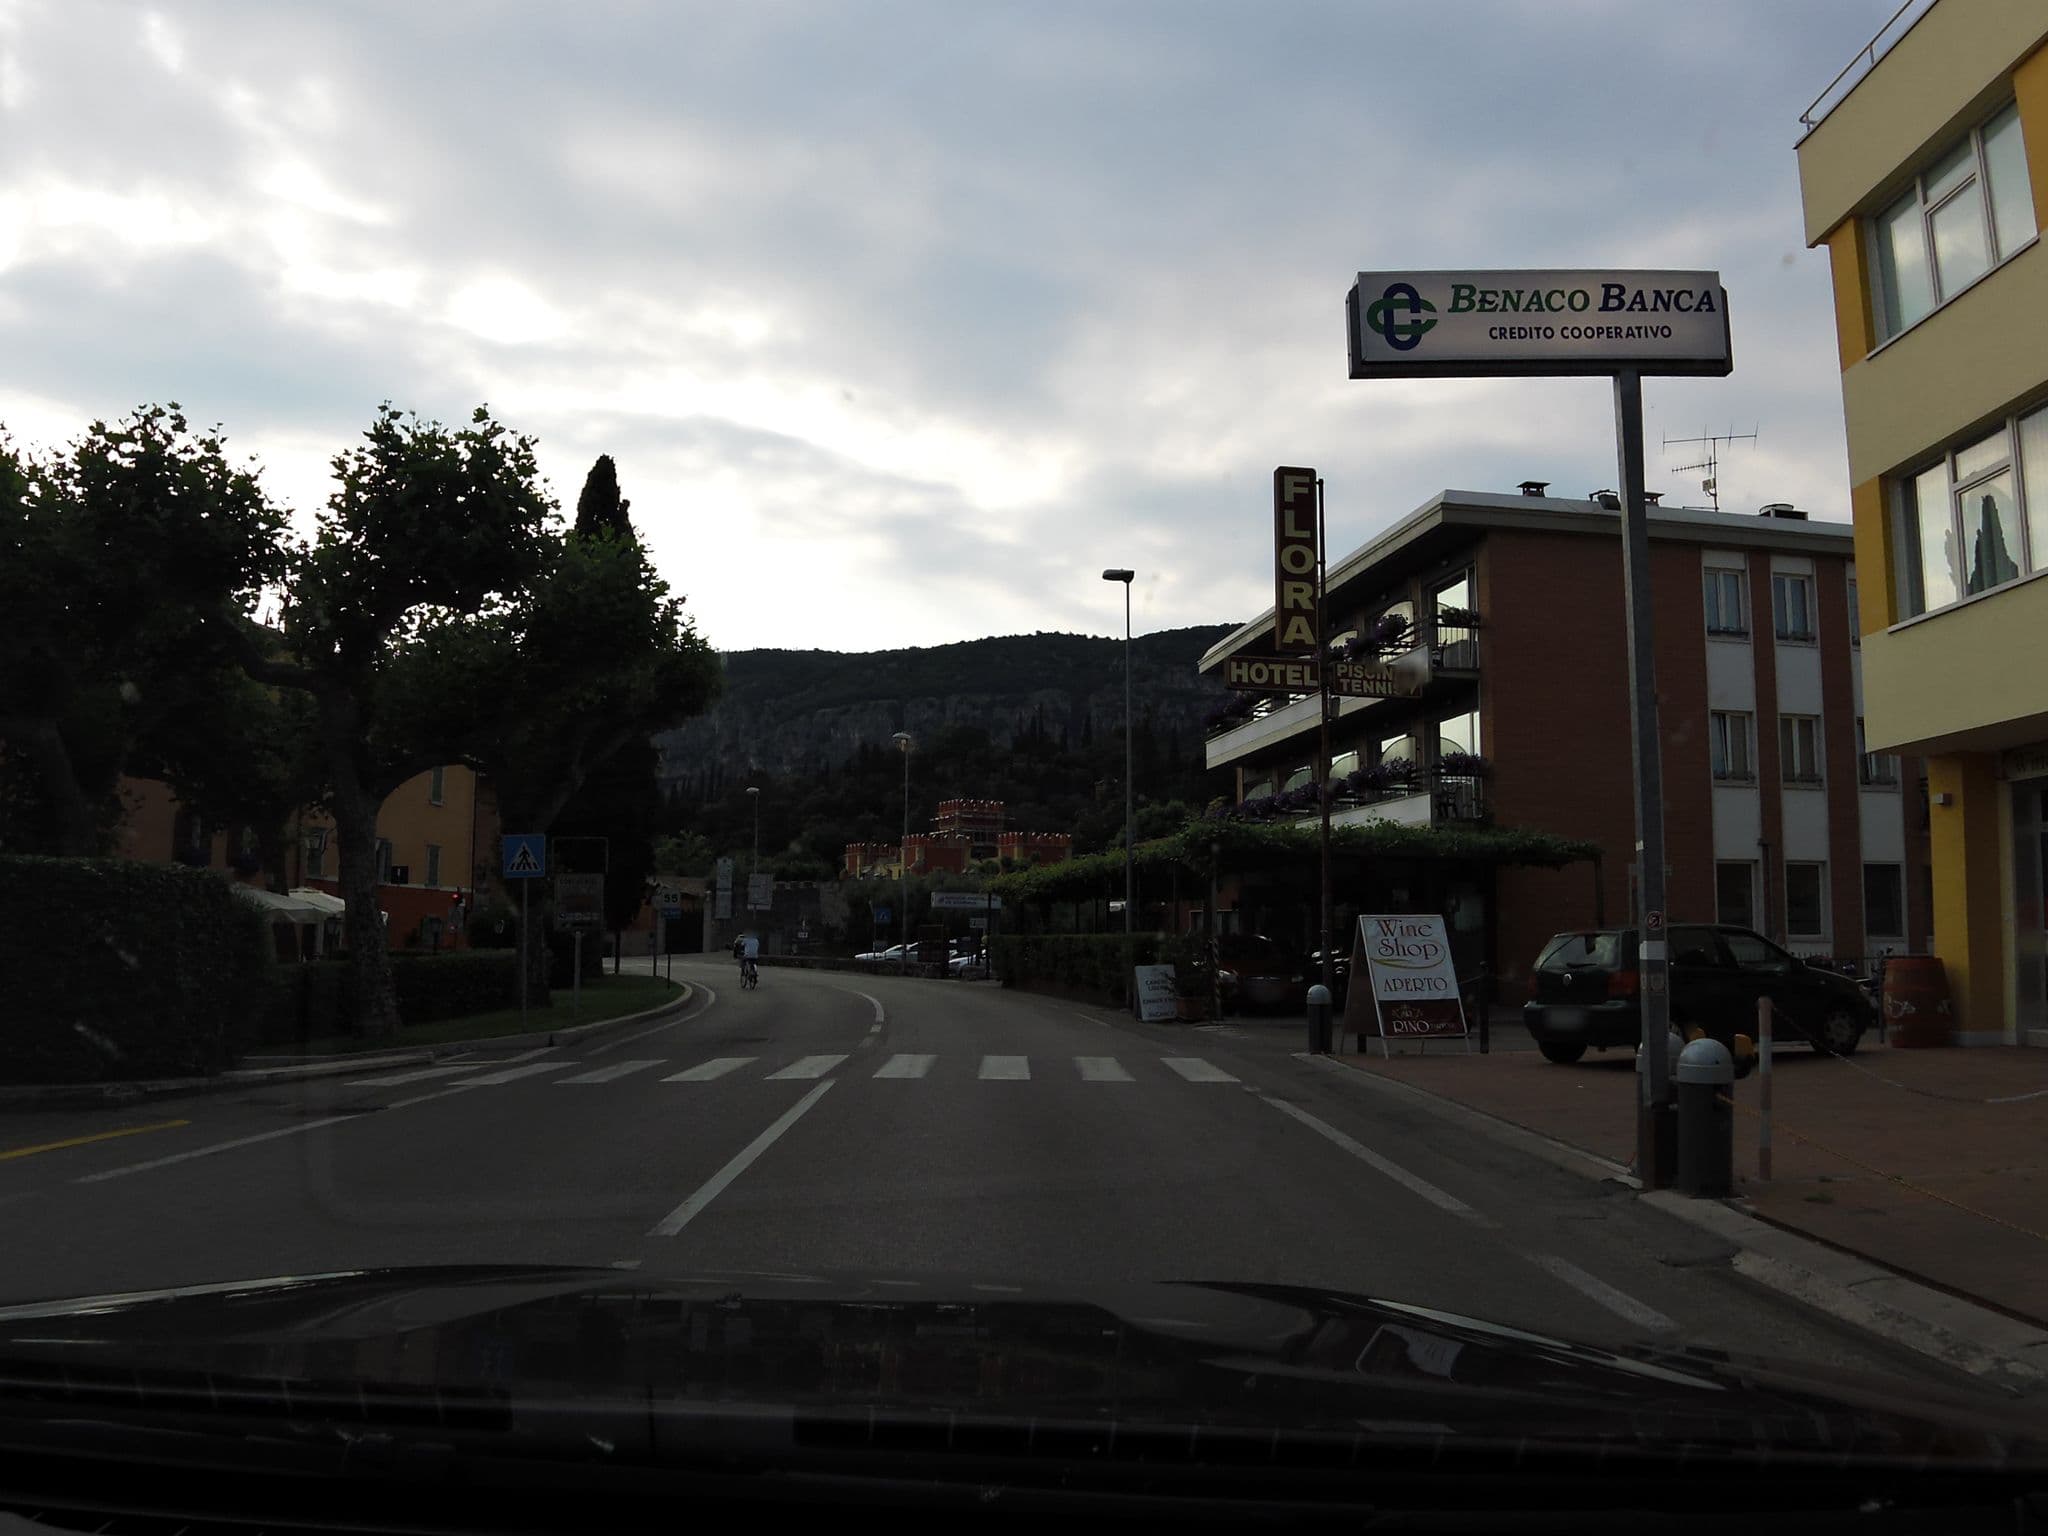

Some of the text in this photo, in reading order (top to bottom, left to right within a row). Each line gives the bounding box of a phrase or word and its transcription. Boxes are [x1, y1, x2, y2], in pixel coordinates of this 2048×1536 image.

[1447, 282, 1716, 313] BENACO BANCA
[1489, 325, 1672, 340] CREDITO COOPERATIVO
[1280, 474, 1317, 646] FLORA
[1230, 660, 1319, 687] HOTEL
[1377, 919, 1433, 937] Wine
[1378, 938, 1438, 960] Shop
[1383, 977, 1448, 992] APERTO
